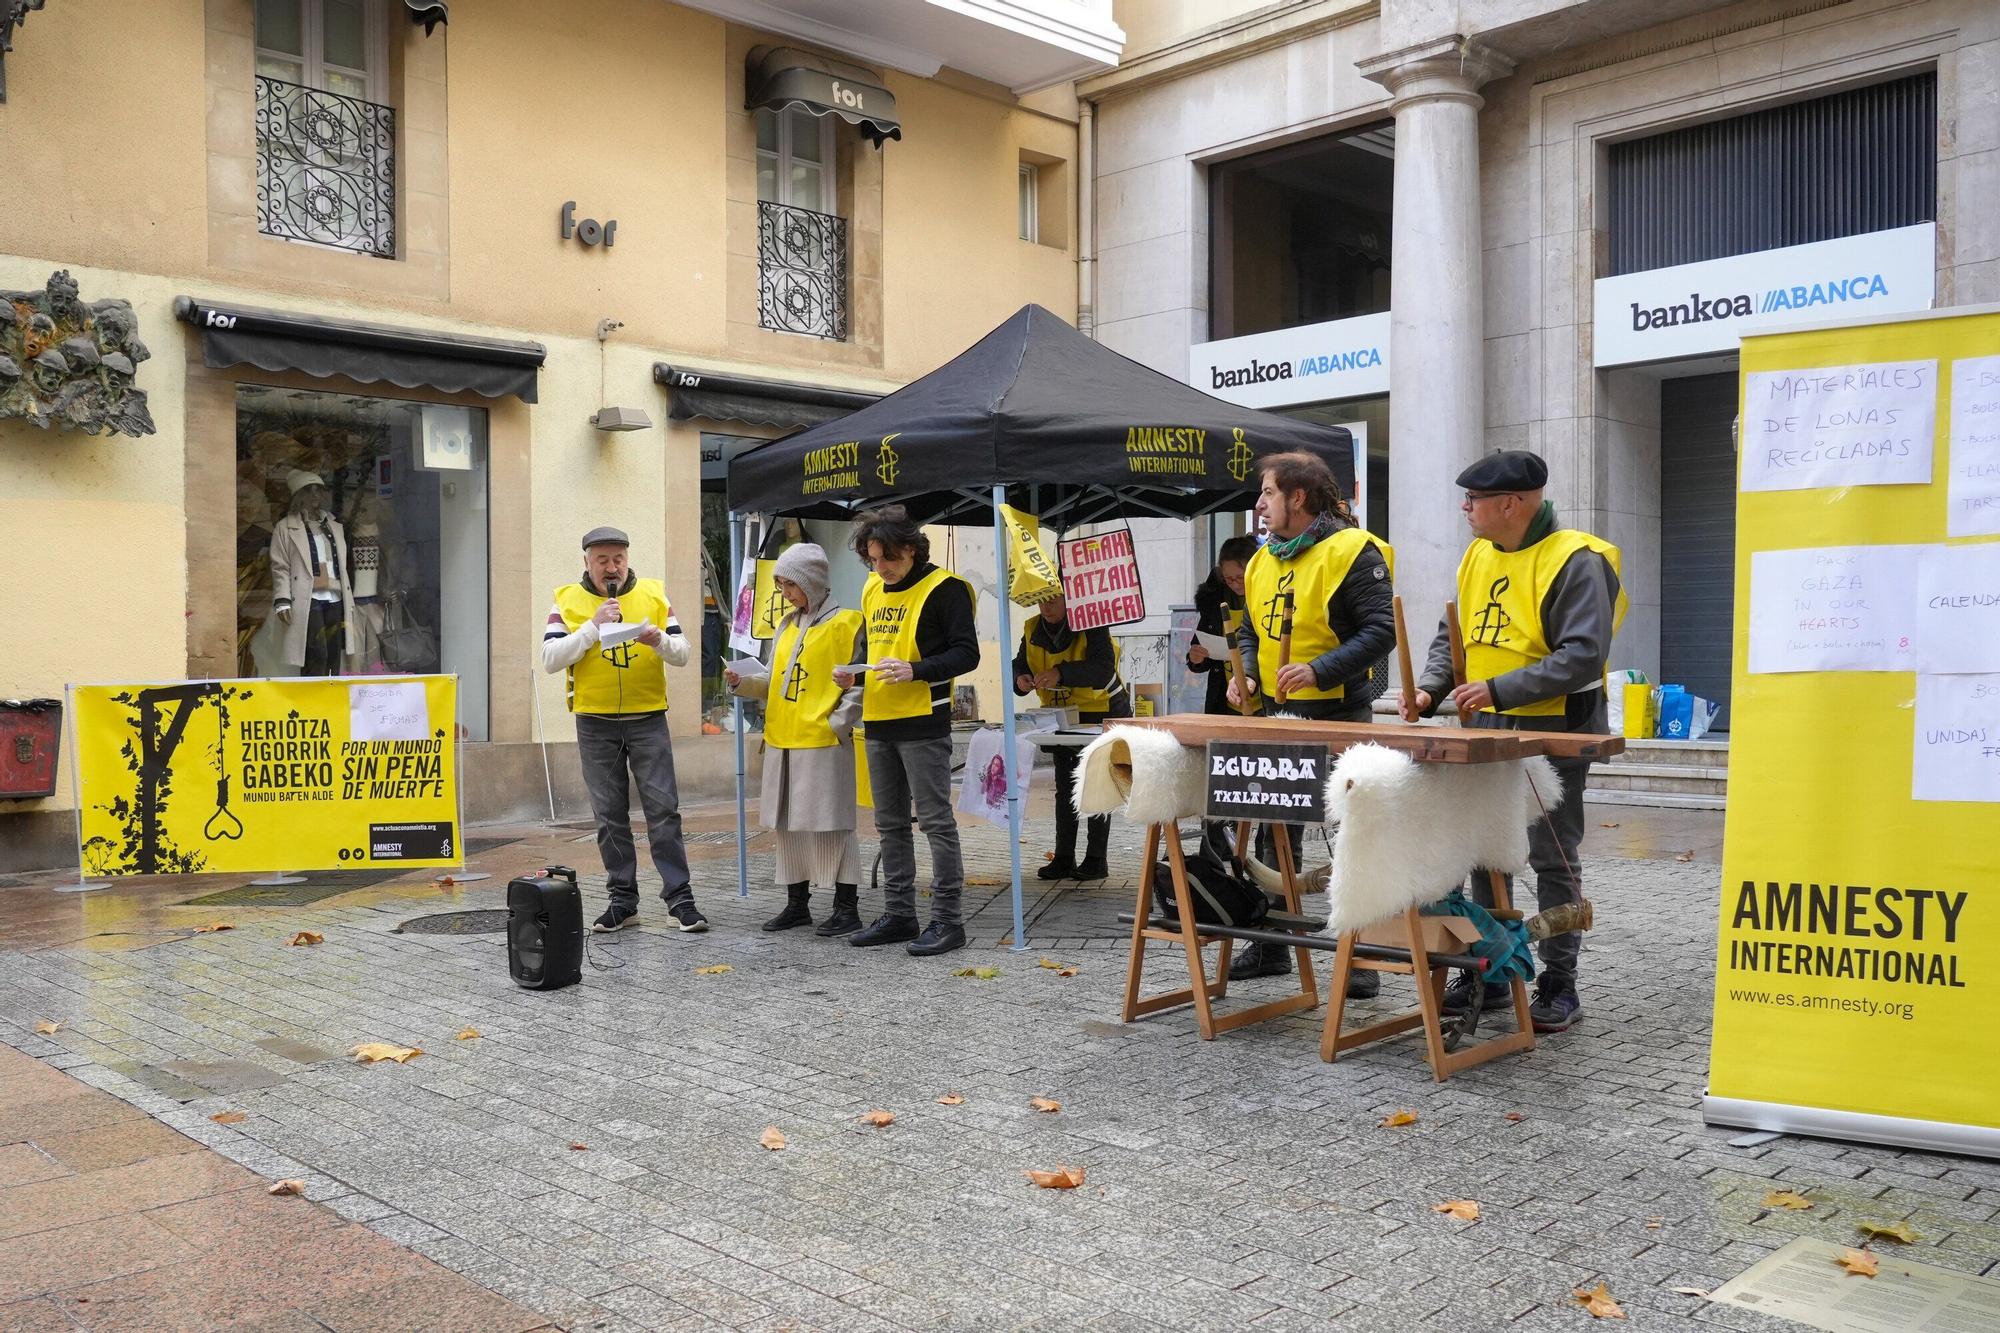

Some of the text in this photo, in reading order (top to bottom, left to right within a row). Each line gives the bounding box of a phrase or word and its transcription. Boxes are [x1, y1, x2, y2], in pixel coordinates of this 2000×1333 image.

[832, 81, 863, 110] for
[561, 201, 617, 246] for
[206, 310, 237, 329] for
[1631, 293, 1753, 332] bankoa
[679, 372, 701, 387] for
[1211, 359, 1293, 389] bankoa
[1763, 407, 1904, 433] DE LONAS
[1126, 427, 1206, 454] AMNESTY
[804, 441, 860, 475] AMNESTY
[1767, 438, 1912, 468] RECICLADAS
[1128, 456, 1207, 475] INTERNATIONAL
[802, 471, 861, 495] INTERNATIONAL
[1801, 575, 1863, 591] GAZA
[1799, 616, 1861, 631] HEARTS
[241, 719, 331, 740] HERIOTZA
[1926, 727, 1987, 744] UNIDAS
[241, 741, 331, 762] ZIGORRIK
[341, 739, 442, 756] POR UN MUNDO
[243, 762, 333, 789] GABEKO
[342, 755, 441, 780] SIN PENA
[1211, 755, 1317, 781] EGURRA
[244, 790, 334, 802] MUNDU BATEN ALDE
[342, 780, 444, 800] DE MUERTE
[1213, 790, 1313, 808] TXALAPARTA
[373, 843, 402, 851] AMNESTY
[1732, 880, 1968, 943] AMNESTY
[1730, 940, 1966, 988] INTERNATIONAL
[1729, 988, 1914, 1020] www.es.amnesty.org
